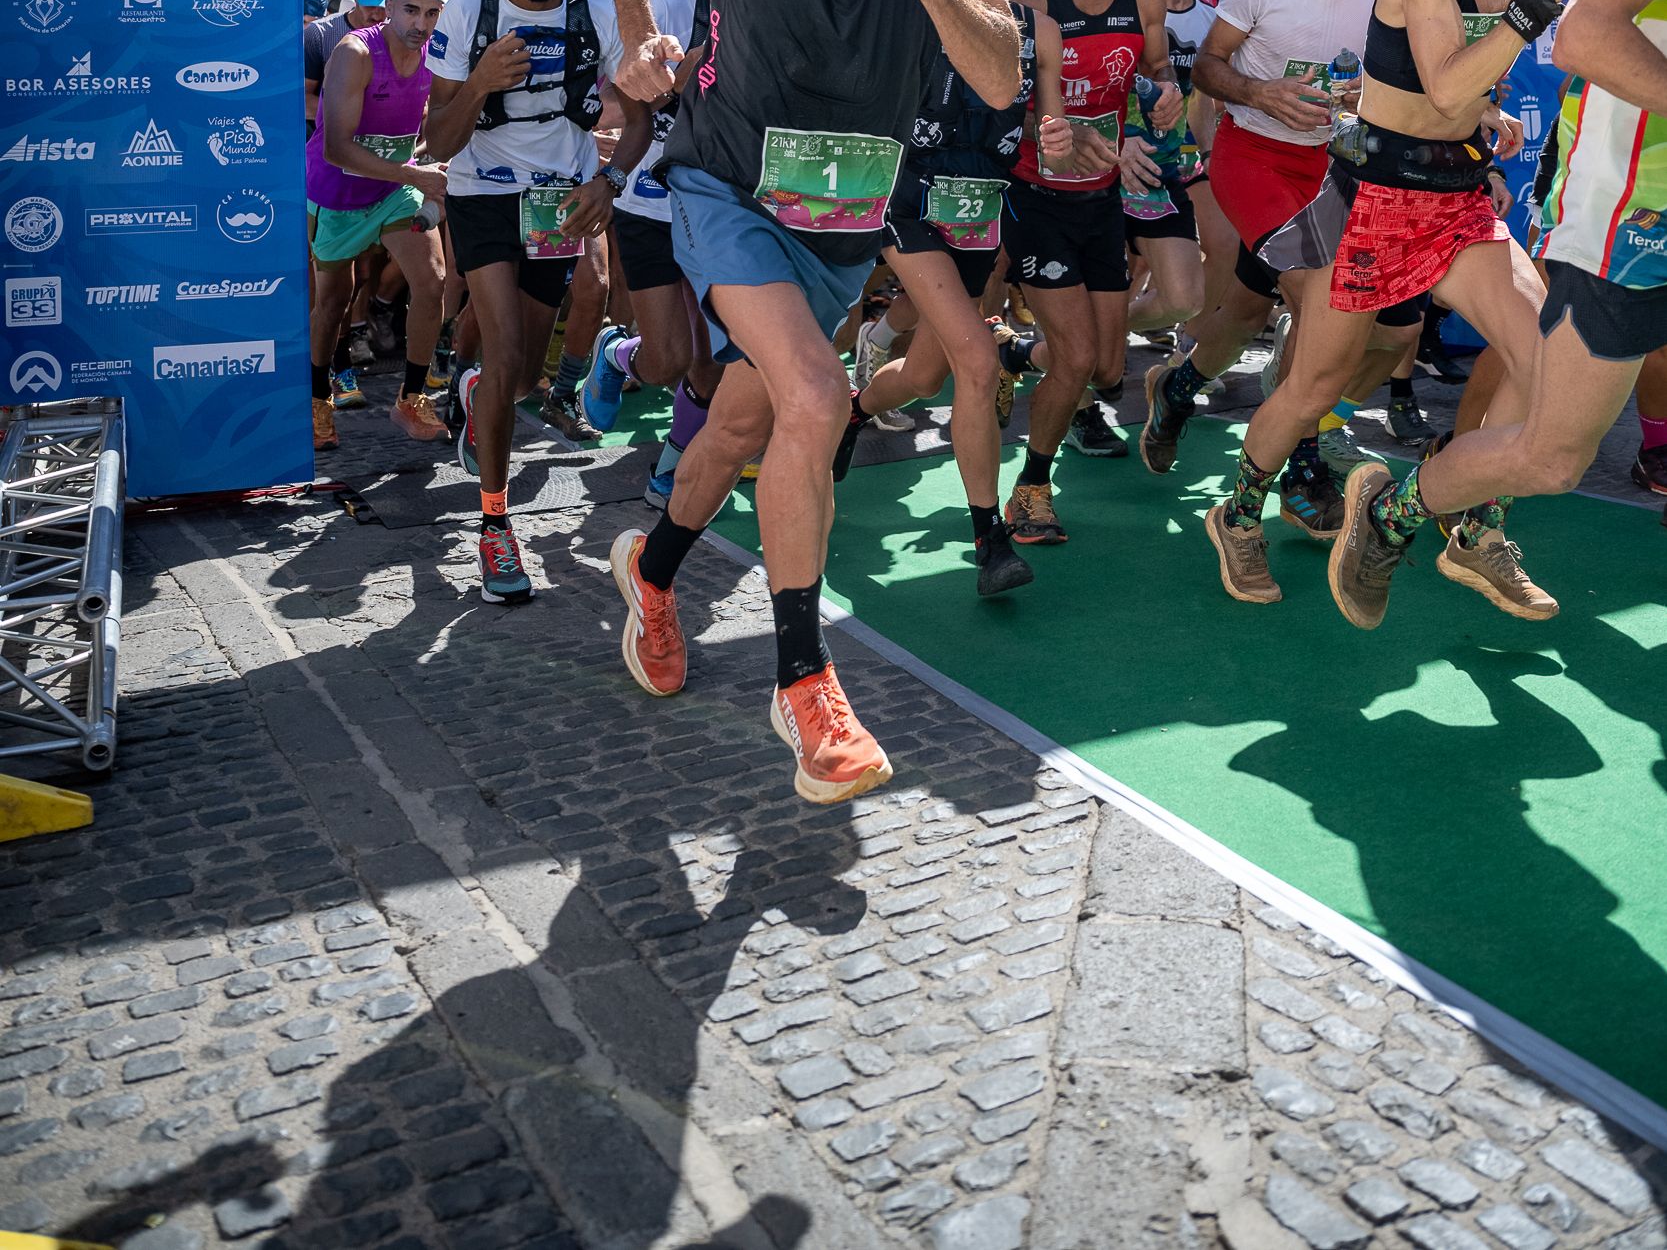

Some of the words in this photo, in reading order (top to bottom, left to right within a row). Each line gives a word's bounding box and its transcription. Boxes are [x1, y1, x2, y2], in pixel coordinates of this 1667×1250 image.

[1513, 6, 1535, 30] GOAL
[6, 78, 44, 92] BQR
[53, 76, 152, 91] ASESORES
[183, 68, 250, 84] Canafruit
[207, 116, 235, 127] Viajes
[224, 129, 254, 144] Pisa
[770, 136, 797, 150] 21KM
[221, 144, 257, 155] Mundo
[121, 155, 183, 167] AONIJIE
[822, 161, 838, 191] 1
[956, 198, 984, 218] 23
[1626, 230, 1665, 250] Teror
[1350, 267, 1373, 278] Teror
[85, 284, 161, 304] TOPTIME
[176, 278, 268, 297] CareSport
[12, 301, 56, 318] 33
[156, 353, 266, 379] Canarias7
